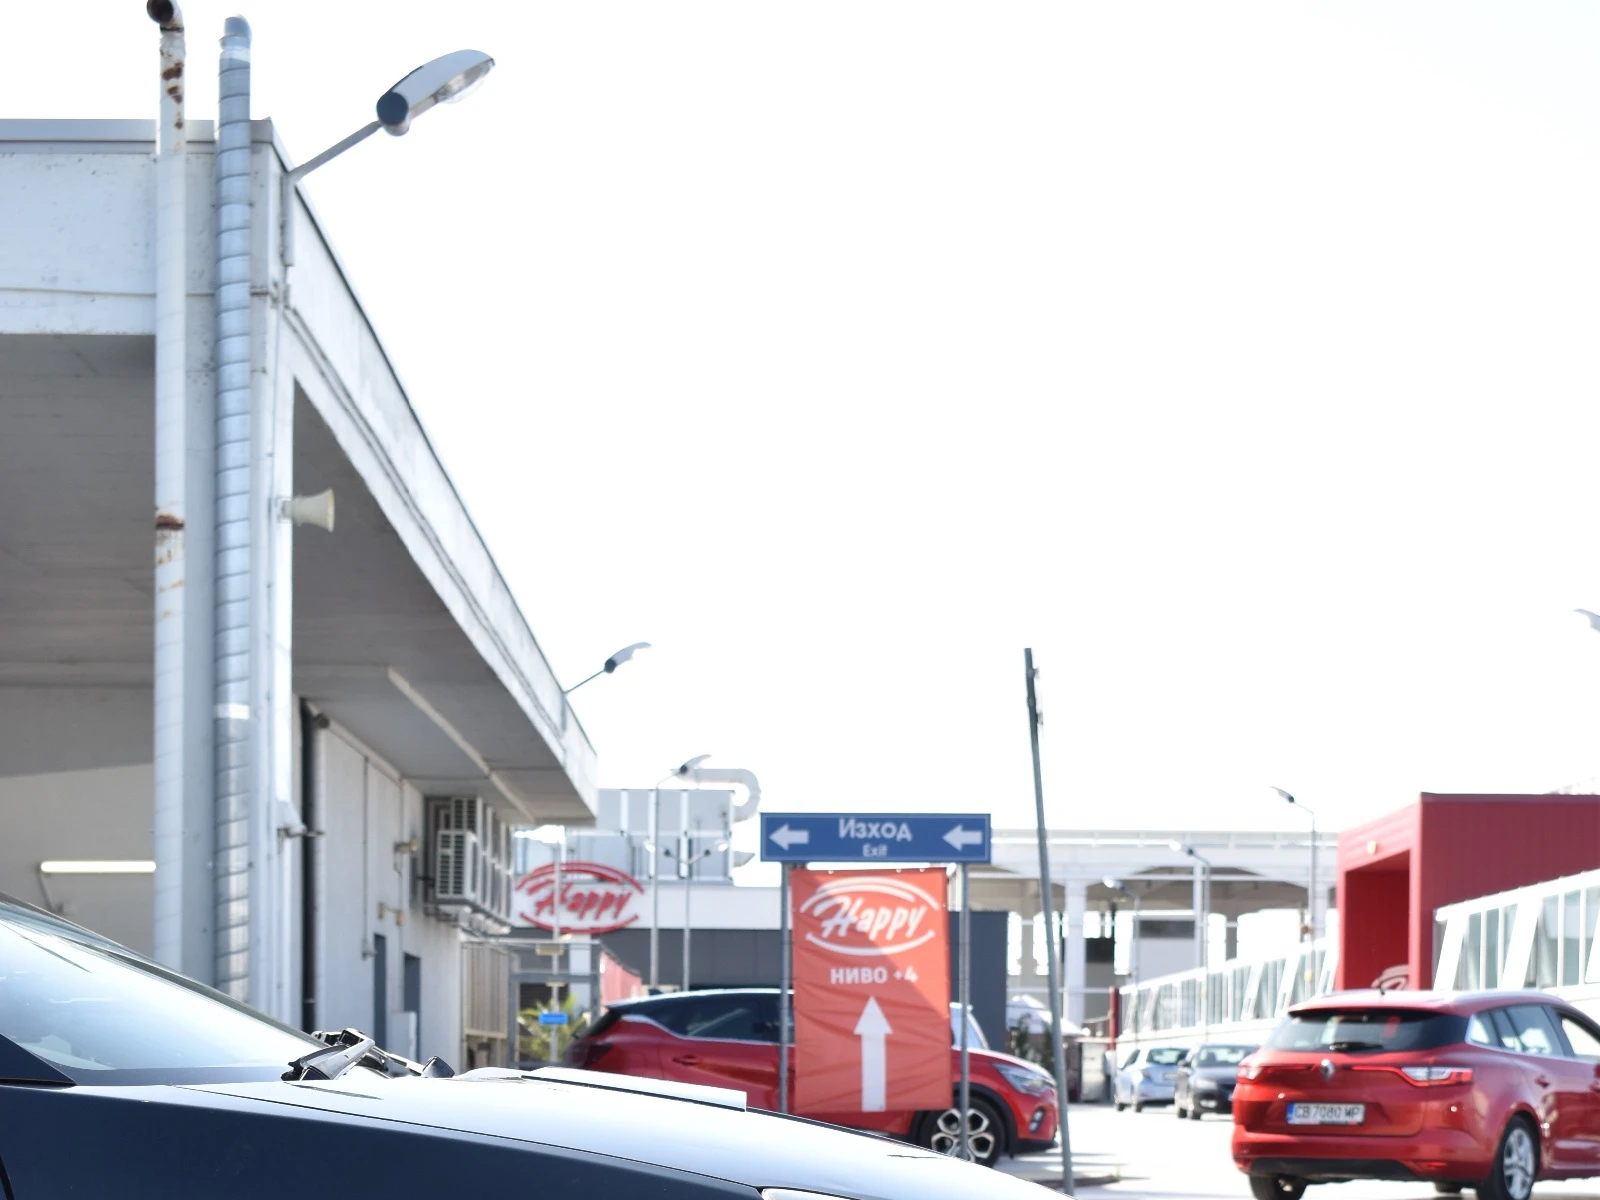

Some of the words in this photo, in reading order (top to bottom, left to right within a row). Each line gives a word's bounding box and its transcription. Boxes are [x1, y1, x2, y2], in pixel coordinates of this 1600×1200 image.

[839, 817, 912, 842] Изход
[863, 844, 888, 858] Exit
[527, 879, 632, 921] Happy
[812, 896, 926, 941] Happy
[830, 967, 888, 984] НИВО
[893, 967, 918, 983] +4
